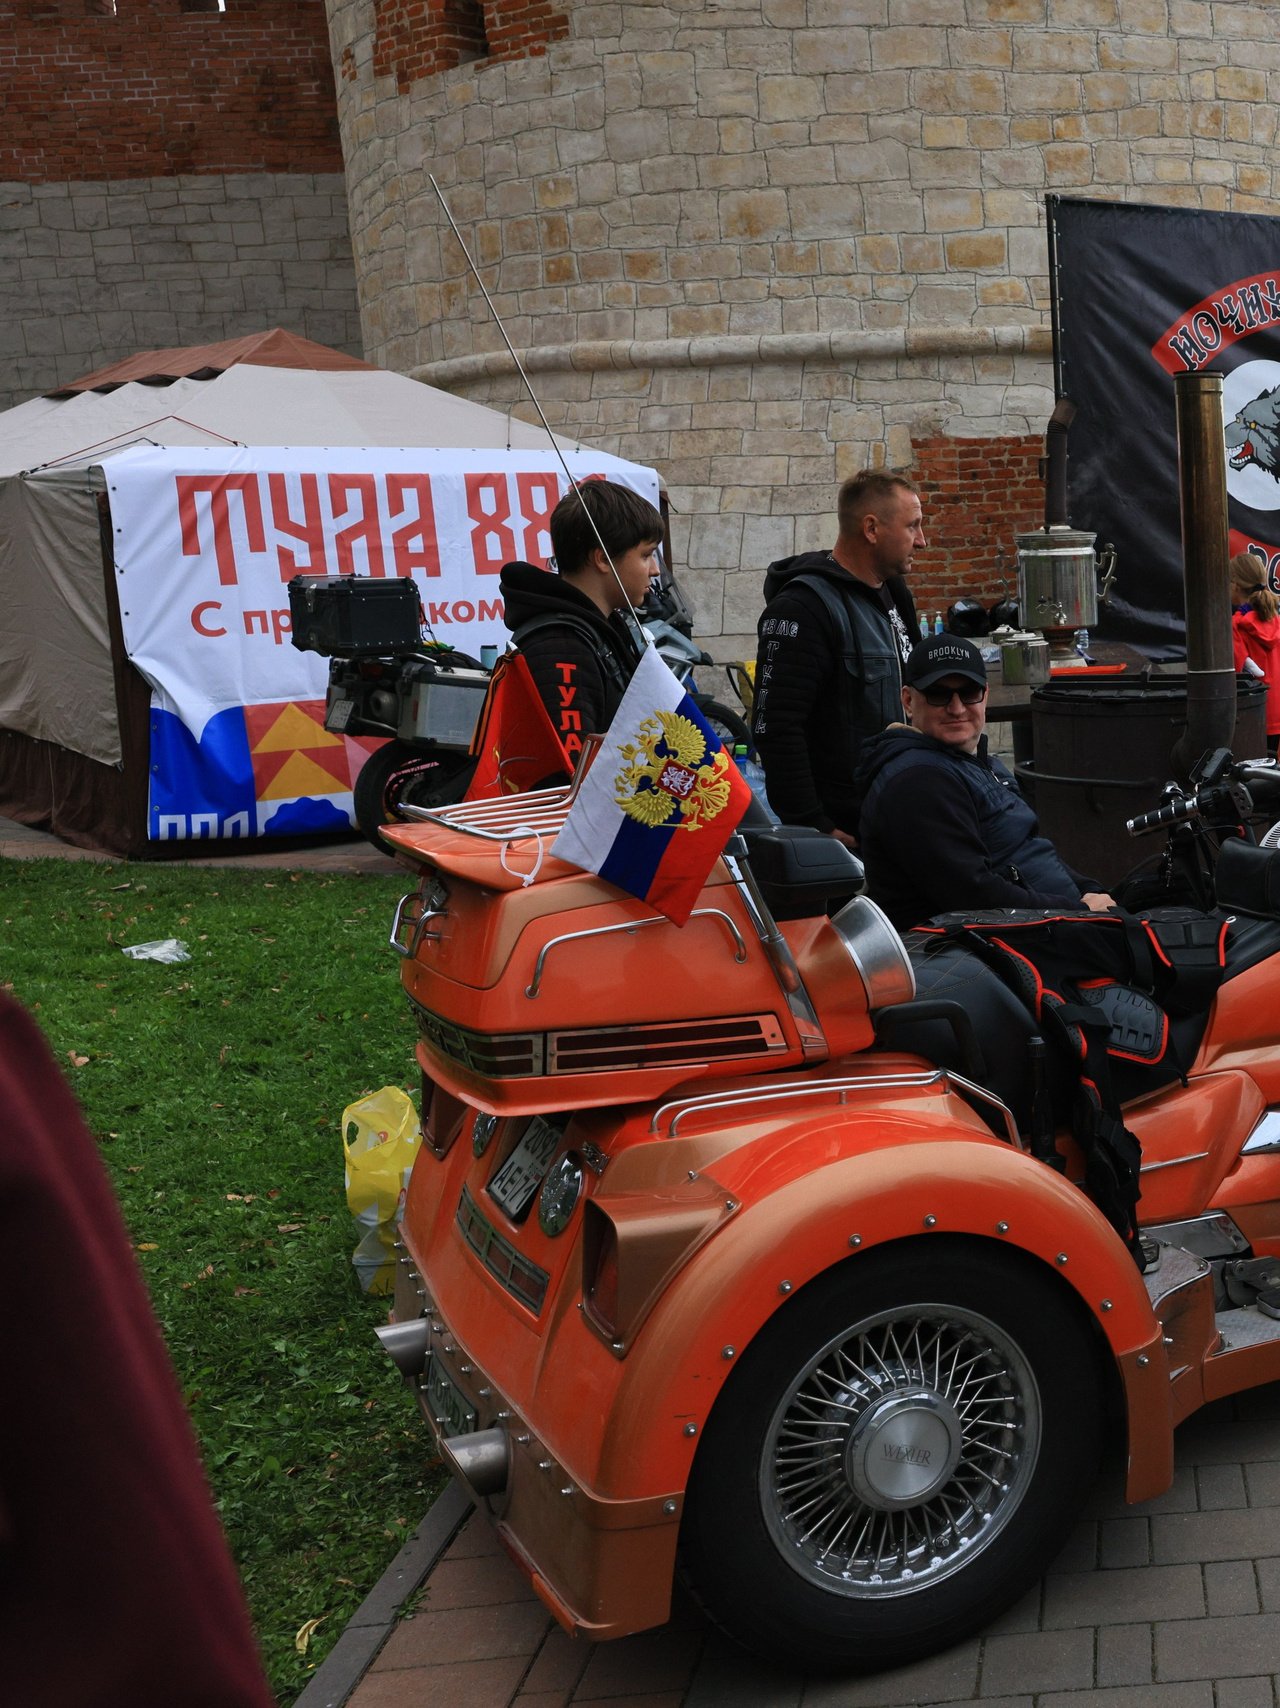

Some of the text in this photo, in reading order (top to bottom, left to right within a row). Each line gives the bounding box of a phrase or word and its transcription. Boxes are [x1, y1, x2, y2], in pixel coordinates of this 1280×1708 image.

[464, 472, 607, 576] 88
[190, 600, 228, 638] С
[928, 645, 970, 660] BROOKLYN
[555, 662, 583, 754] ТУЛА
